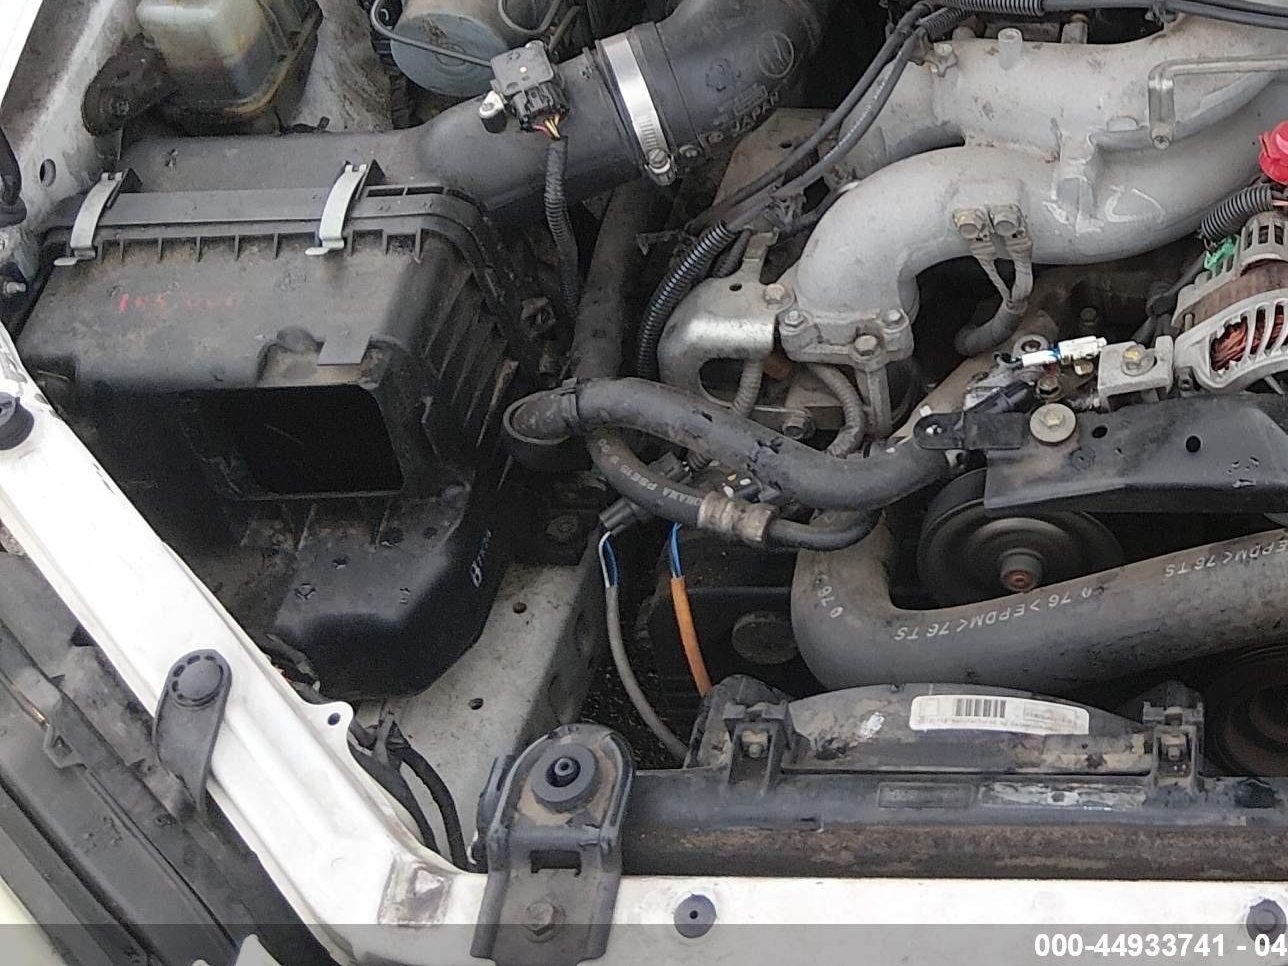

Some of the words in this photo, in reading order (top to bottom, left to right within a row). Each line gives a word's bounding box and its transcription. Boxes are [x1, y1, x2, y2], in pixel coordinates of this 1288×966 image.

[1164, 561, 1193, 578] TS
[1047, 590, 1072, 608] 76
[893, 626, 920, 641] TS
